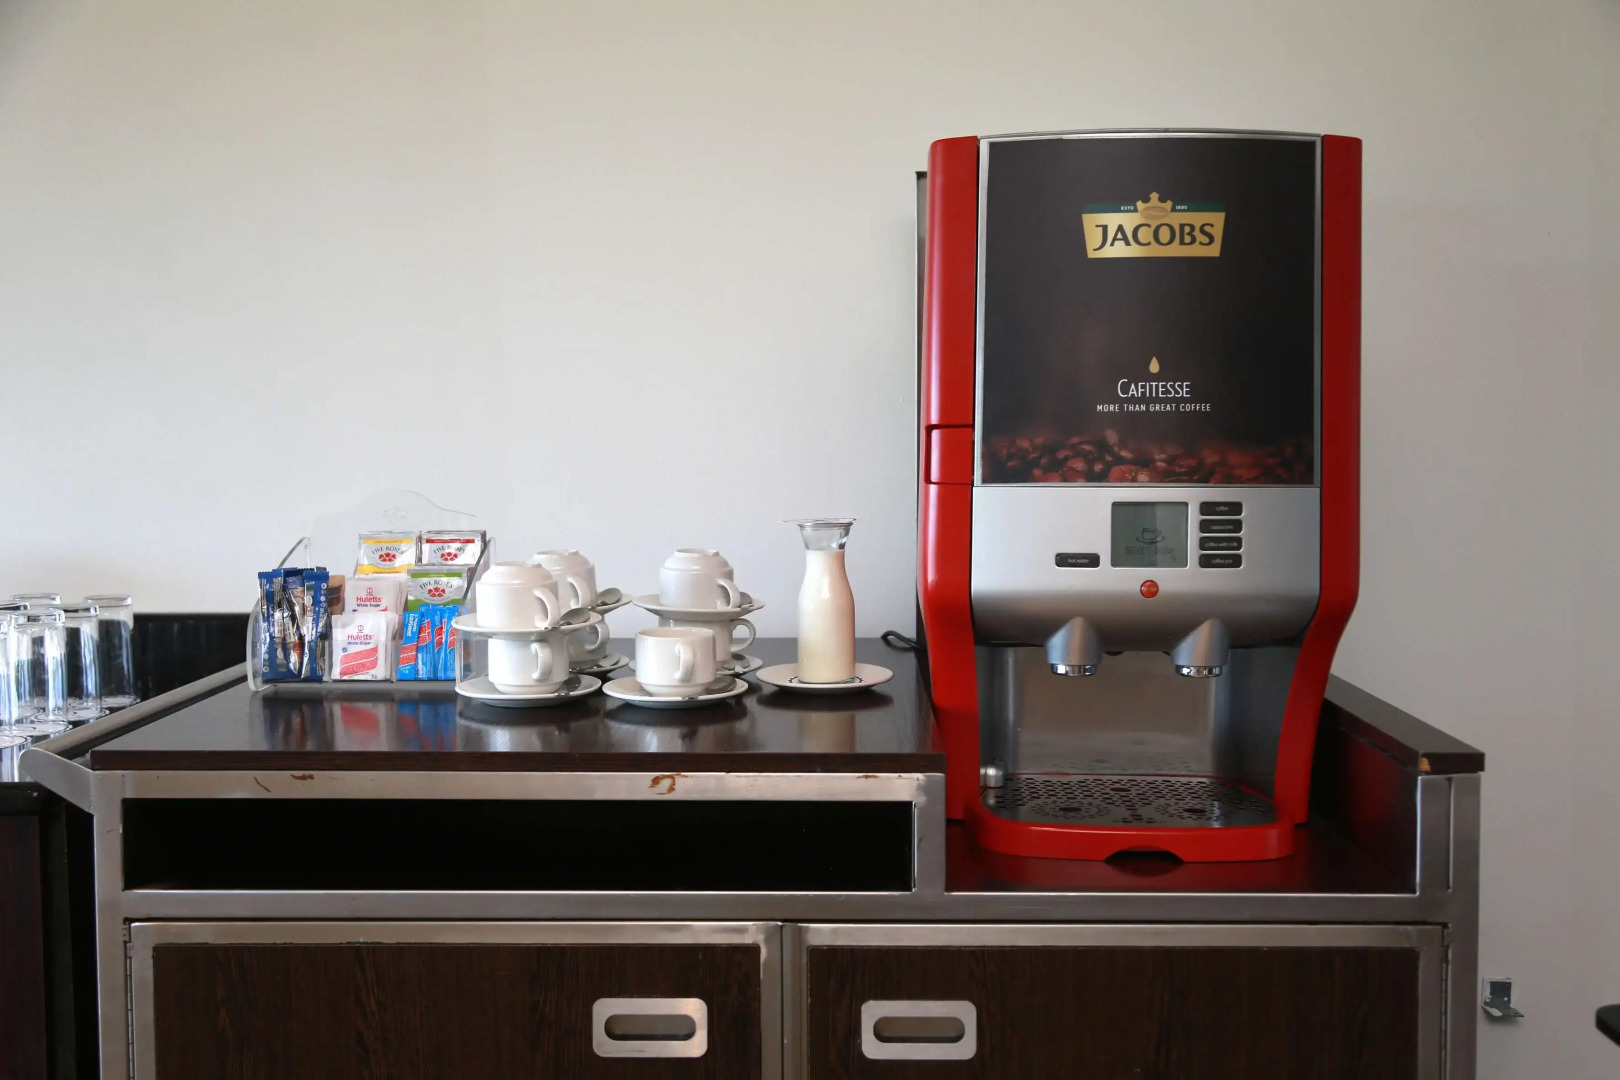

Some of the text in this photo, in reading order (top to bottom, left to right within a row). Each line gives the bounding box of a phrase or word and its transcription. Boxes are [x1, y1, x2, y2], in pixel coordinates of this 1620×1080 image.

[1093, 222, 1215, 252] JACOBS
[1096, 403, 1211, 412] MORE THAN GREAT COFFEE
[372, 546, 384, 555] FIVE
[419, 581, 432, 590] FIVE
